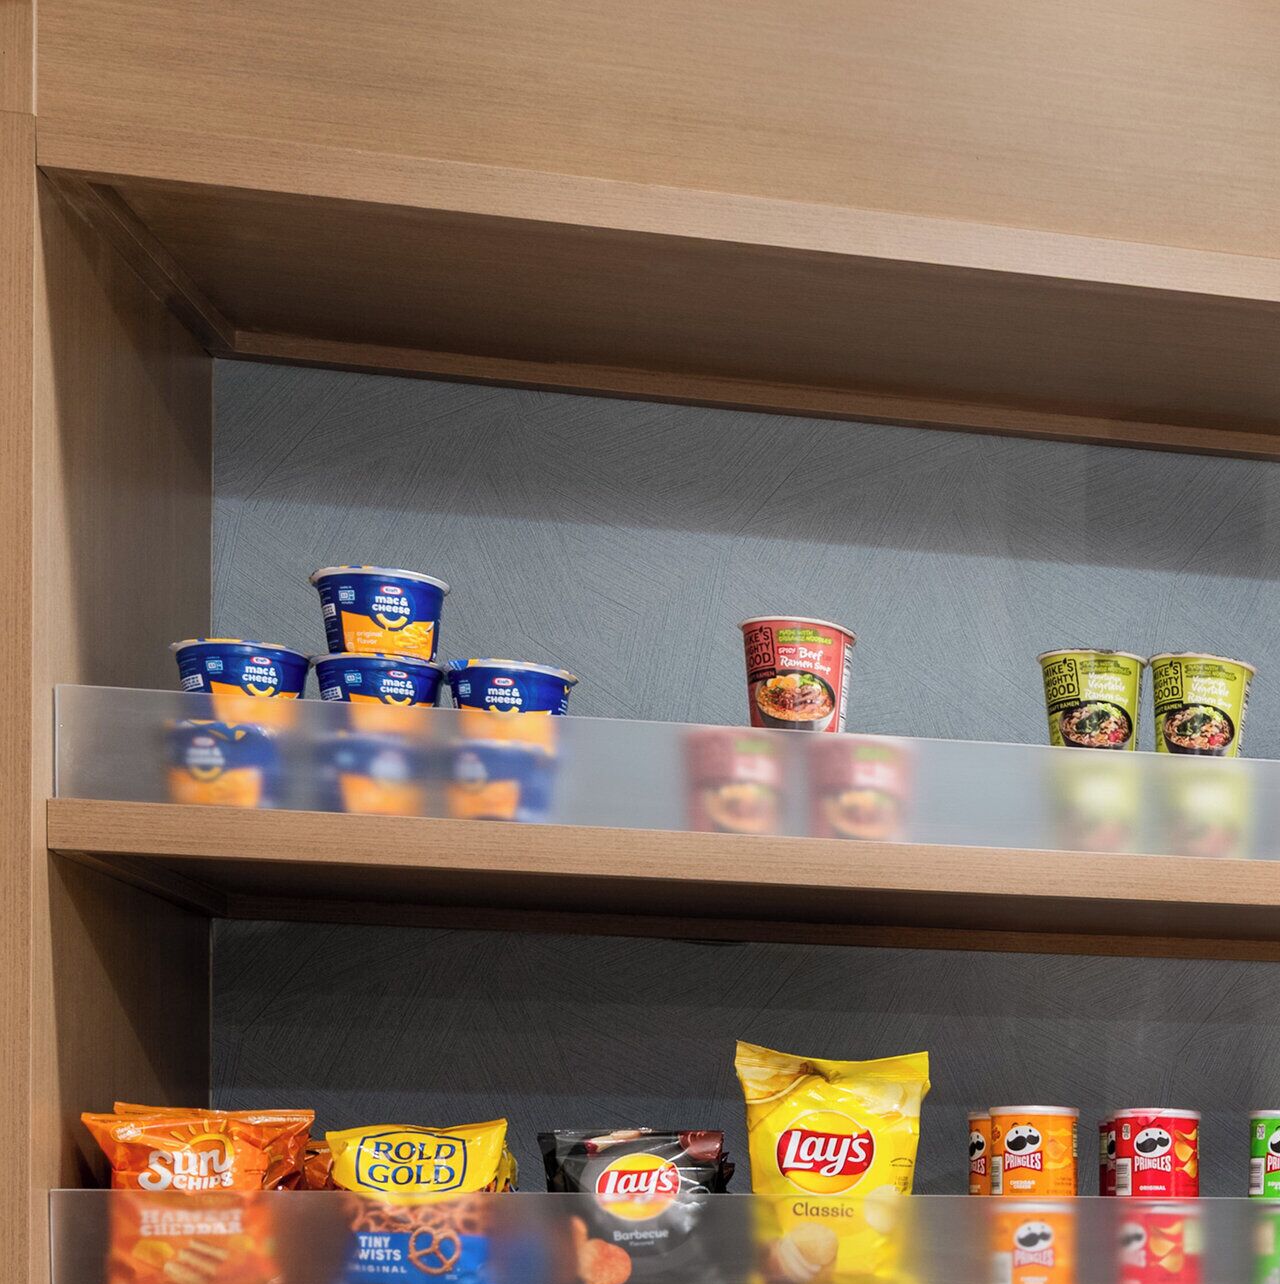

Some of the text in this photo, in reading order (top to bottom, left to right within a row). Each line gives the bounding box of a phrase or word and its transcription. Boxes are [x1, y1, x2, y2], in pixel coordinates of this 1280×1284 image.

[780, 655, 813, 669] Ramen
[798, 647, 823, 660] Beef
[372, 1141, 456, 1164] ROLD
[782, 1130, 870, 1177] Lay's
[1004, 1152, 1042, 1171] PRINGLES
[138, 1148, 235, 1191] Sun
[1134, 1156, 1172, 1172] PRINGLES
[171, 1172, 235, 1191] CHIPS
[368, 1163, 455, 1186] GOLD
[792, 1201, 855, 1219] Classic
[359, 1235, 391, 1248] TINY
[613, 1228, 669, 1243] Barbecue
[357, 1248, 402, 1261] WISTS
